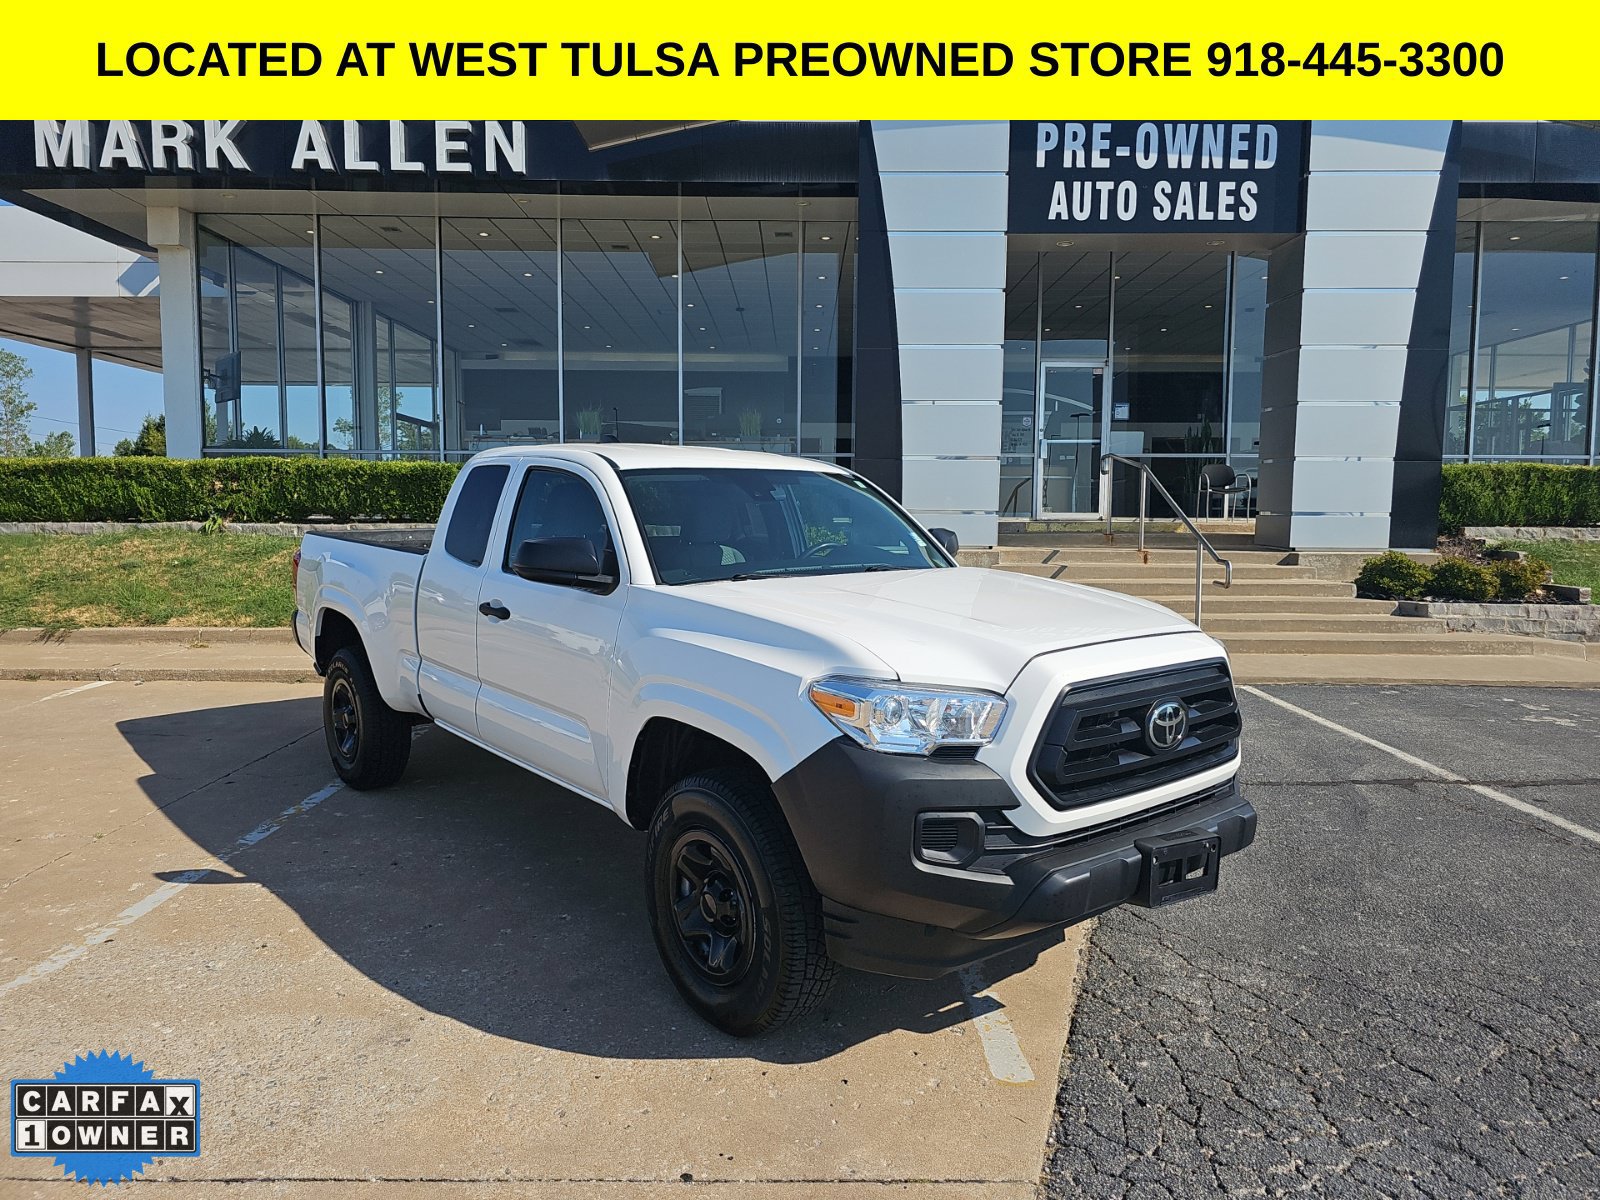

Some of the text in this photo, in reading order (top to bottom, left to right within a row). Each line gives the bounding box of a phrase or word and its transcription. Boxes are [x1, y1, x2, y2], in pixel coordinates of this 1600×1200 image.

[34, 120, 526, 174] MARK ALLEN
[1036, 122, 1278, 170] PRE-OWNED
[1048, 180, 1258, 222] AUTO SALES
